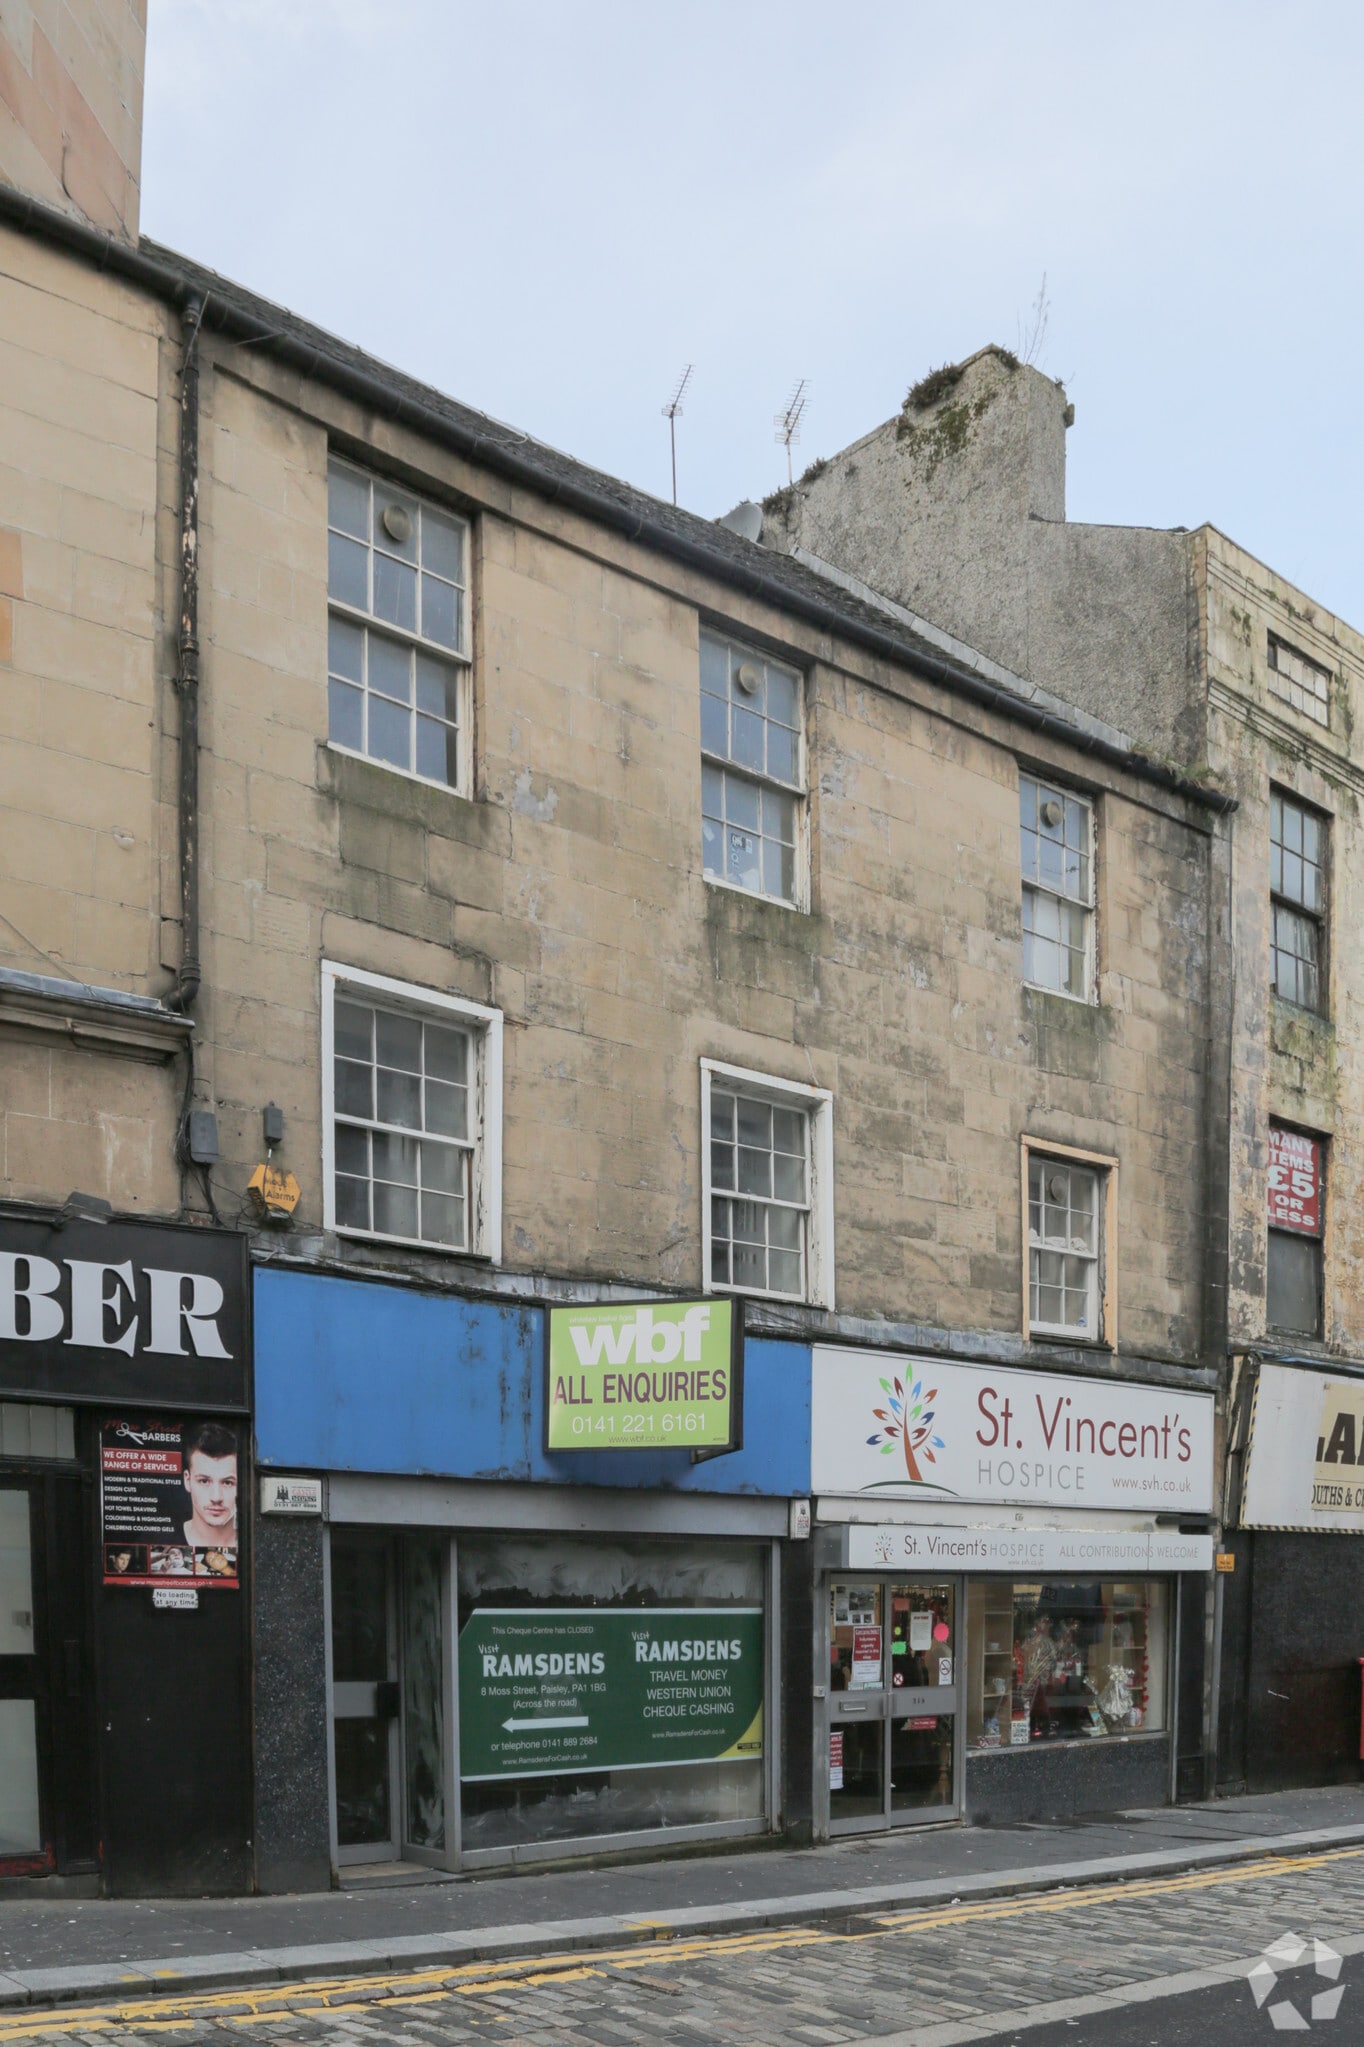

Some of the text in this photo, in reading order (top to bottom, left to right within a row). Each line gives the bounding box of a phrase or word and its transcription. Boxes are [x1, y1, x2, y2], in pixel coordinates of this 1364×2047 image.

[1268, 1148, 1314, 1173] TEMS
[1267, 1164, 1315, 1198] £5
[1275, 1194, 1304, 1211] OR
[1267, 1205, 1315, 1226] LESS
[0, 1251, 234, 1359] BER
[568, 1305, 711, 1366] wbf
[553, 1369, 727, 1404] ALL ENQUIRIES
[572, 1413, 706, 1434] 0141 221 6161
[976, 1387, 1191, 1462] St. Vincent's
[142, 1432, 181, 1443] BARBERS
[608, 1434, 667, 1443] www.wbf.co.uk
[103, 1450, 167, 1461] WE OFFER A WIDE
[103, 1461, 177, 1472] RANGE OF SERVICES
[978, 1459, 1085, 1490] HOSPICE
[1112, 1475, 1192, 1493] www.svh.co.uk
[1344, 1487, 1353, 1507] &
[904, 1535, 1199, 1559] St. Vincent's HOSPICE ALL CONTRIBUTIONS WELCOME
[168, 1591, 195, 1600] loading
[491, 1626, 594, 1636] This Cheque Centre has CLOSED
[631, 1631, 650, 1641] Visit
[478, 1644, 500, 1655] Visit
[635, 1639, 742, 1662] RAMSDENS
[482, 1652, 605, 1677] RAMSDENS
[649, 1669, 728, 1682] TRAVEL MONEY
[480, 1682, 607, 1696] 8 Moss Street, Paisley, PA1 1BG
[646, 1686, 732, 1700] WESTERN UNION
[513, 1698, 578, 1710] (Across the road)
[642, 1703, 735, 1718] CHEQUE CASHING
[490, 1743, 499, 1751] or
[501, 1740, 541, 1751] telephone
[541, 1738, 561, 1748] 0141
[579, 1736, 598, 1746] 2684
